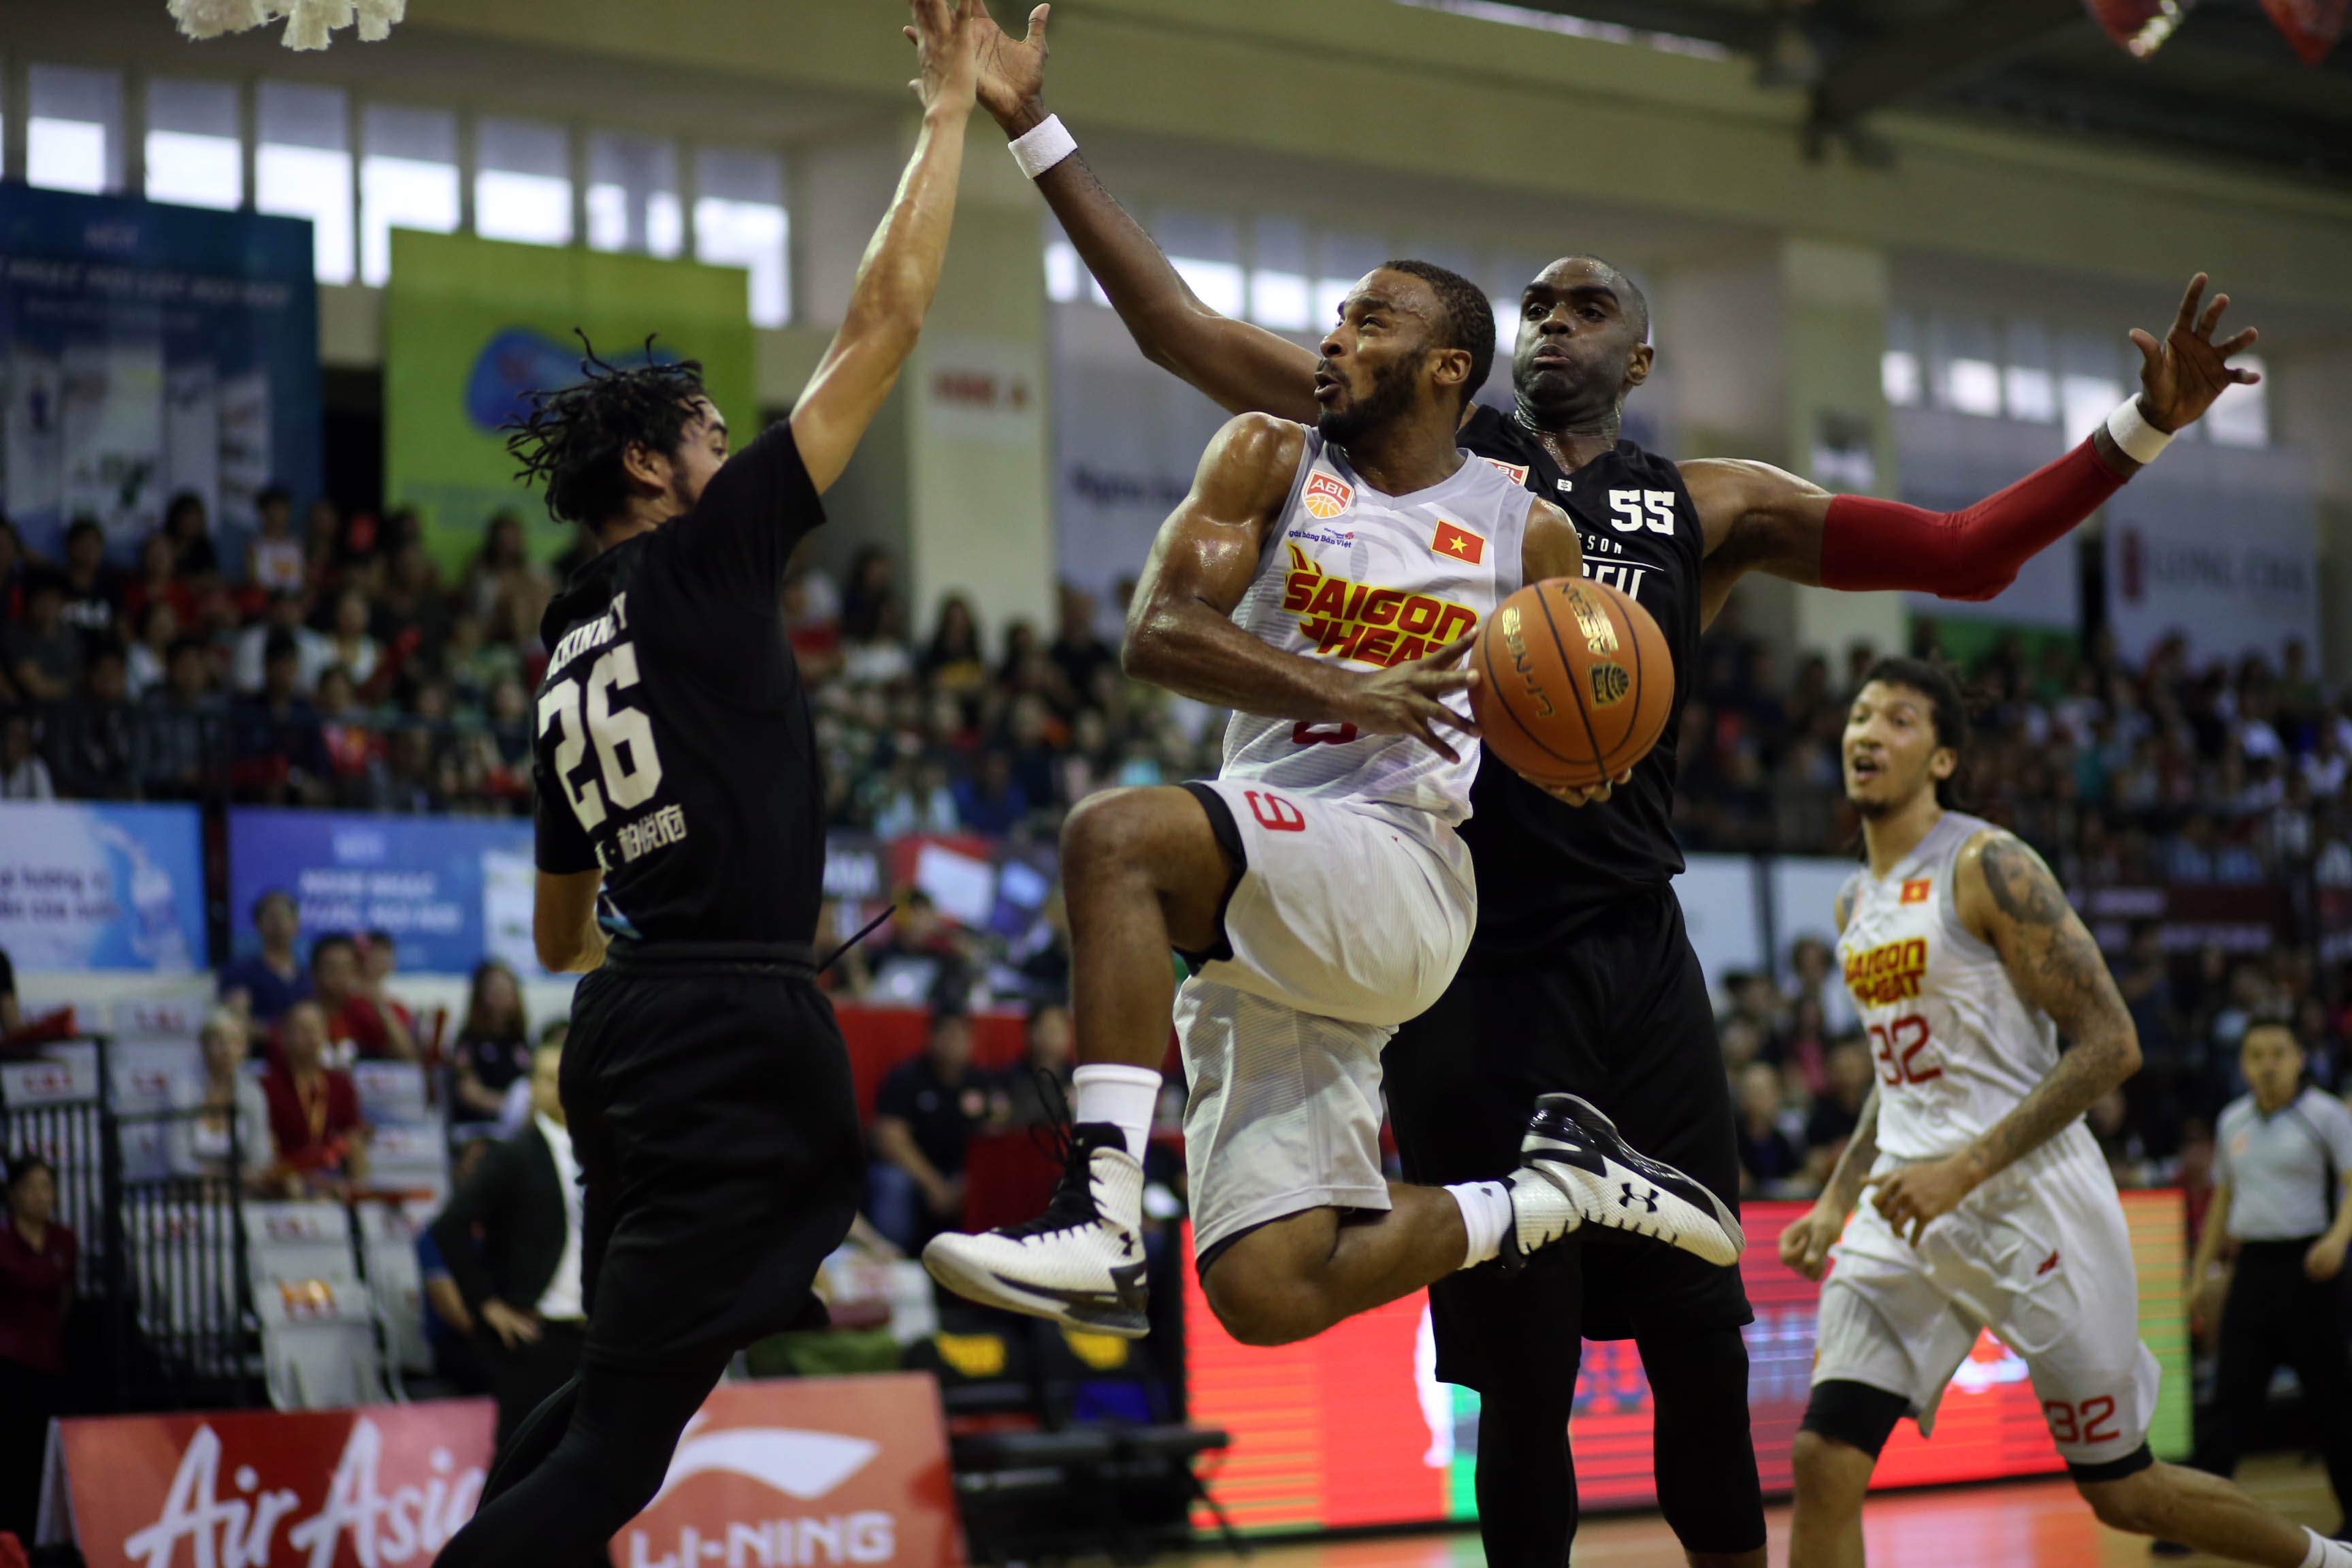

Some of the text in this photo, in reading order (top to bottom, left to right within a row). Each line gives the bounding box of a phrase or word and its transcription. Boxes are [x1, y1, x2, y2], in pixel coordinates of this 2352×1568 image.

[1310, 478, 1346, 502] ABL
[1609, 489, 1675, 536] 55
[1284, 570, 1478, 642] SAIGON
[1501, 605, 1555, 717] LI-NING
[538, 641, 663, 833] 26
[1243, 790, 1306, 832] 9
[1870, 1014, 1942, 1085] 32
[2044, 1394, 2121, 1443] 32
[630, 1509, 896, 1568] LI-NING
